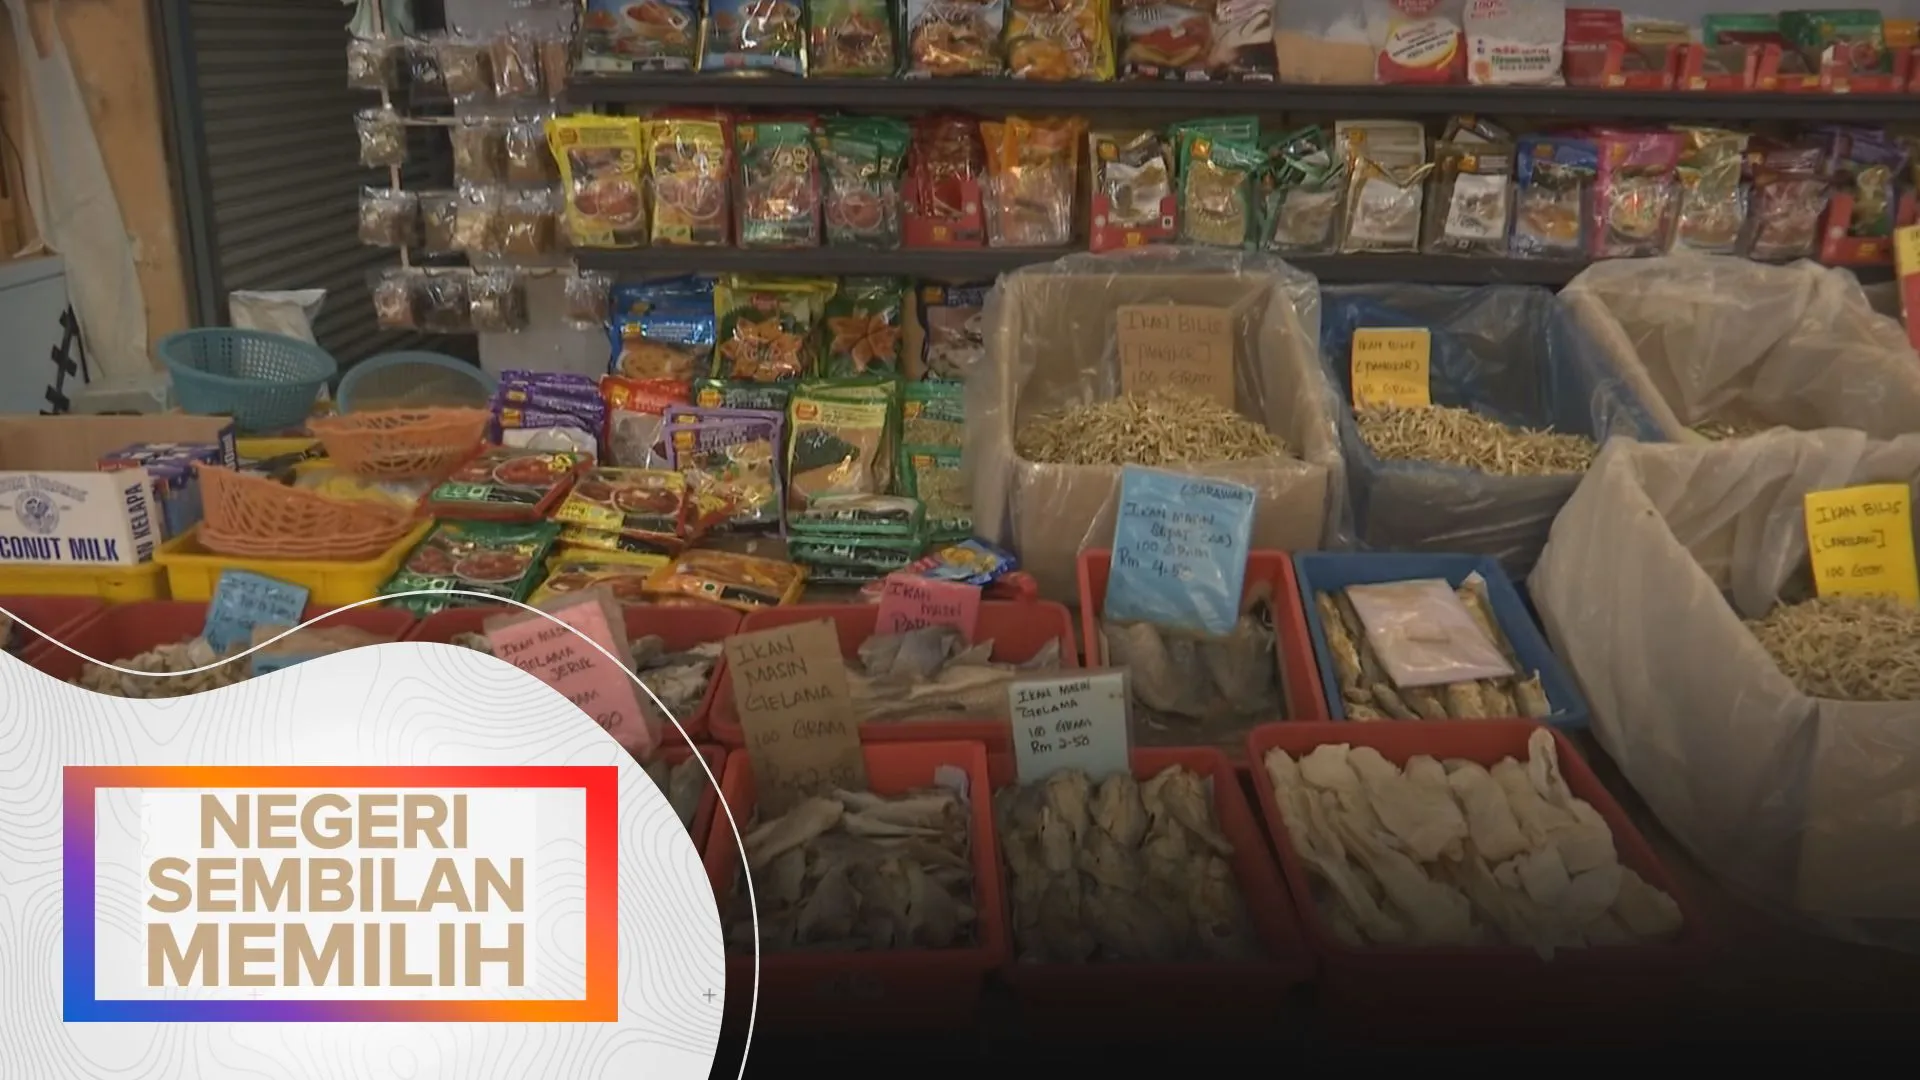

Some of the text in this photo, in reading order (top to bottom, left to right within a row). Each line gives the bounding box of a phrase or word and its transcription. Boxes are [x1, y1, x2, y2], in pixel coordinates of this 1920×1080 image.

[125, 482, 152, 540] KELAPA
[1124, 502, 1167, 519] IKAN
[1816, 504, 1857, 525] IKAN
[68, 537, 120, 562] MILK
[1136, 540, 1159, 551] 100
[887, 582, 931, 601] IKAN
[735, 634, 796, 667] IKAN
[744, 658, 808, 686] MASIN
[744, 685, 836, 712] GELAMA
[1017, 688, 1052, 704] IKAN
[792, 718, 847, 740] GRAM
